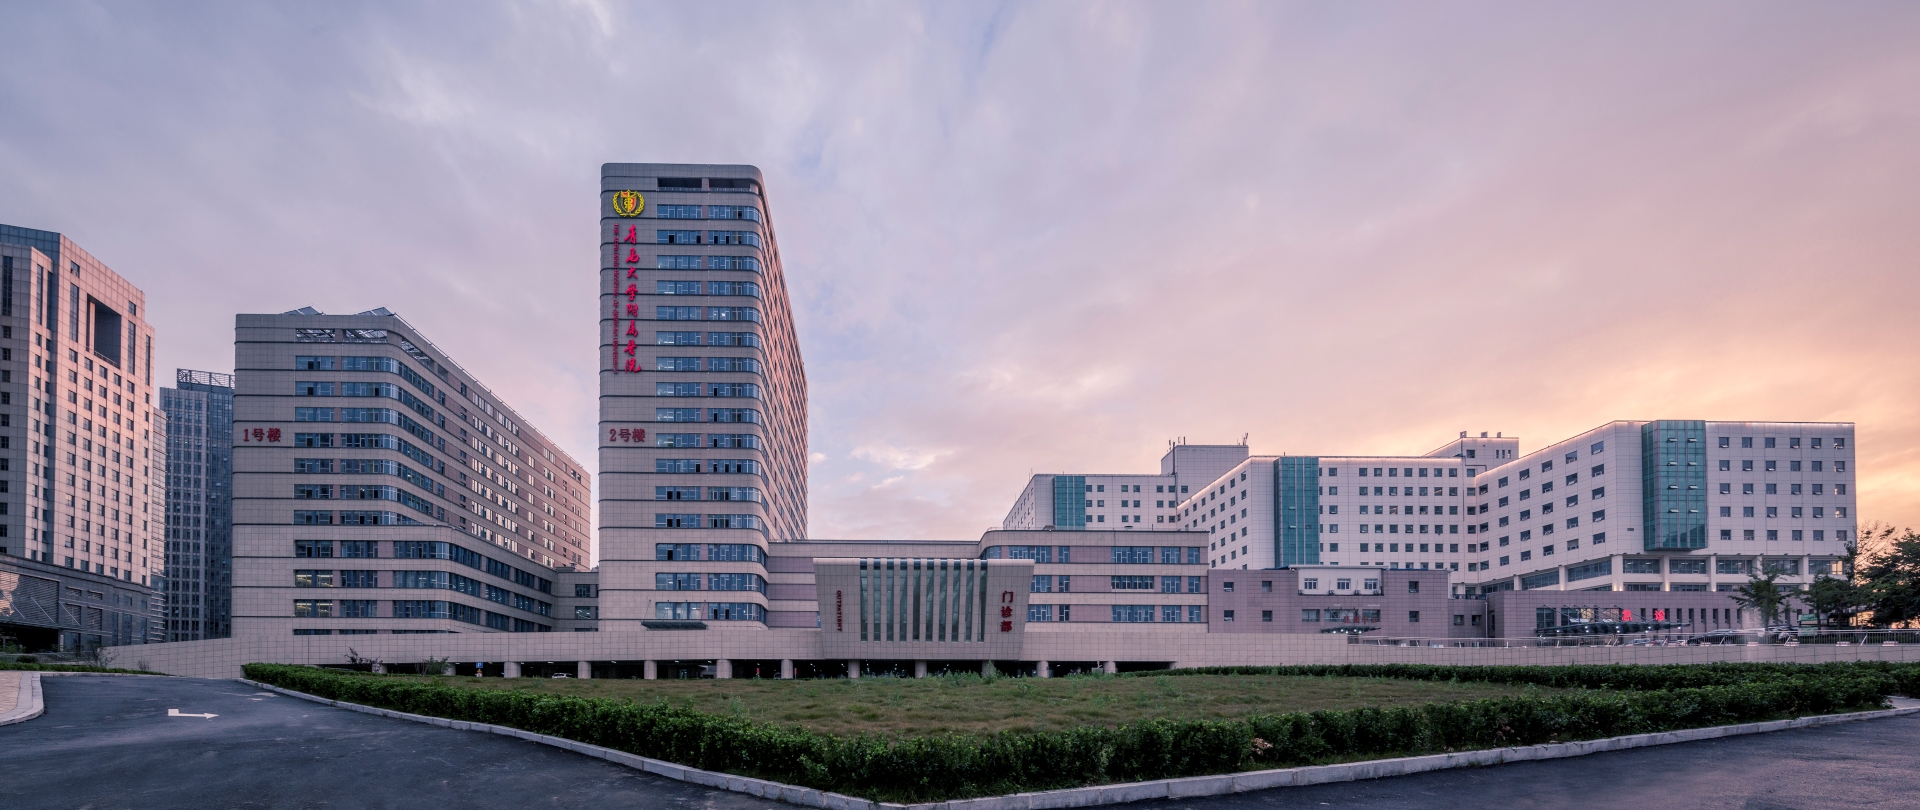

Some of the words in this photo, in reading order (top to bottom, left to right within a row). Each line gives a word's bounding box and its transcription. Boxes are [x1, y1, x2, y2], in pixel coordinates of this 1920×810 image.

[243, 427, 281, 442] 1号楼
[609, 427, 646, 443] 2号楼
[1001, 590, 1014, 632] 门诊部
